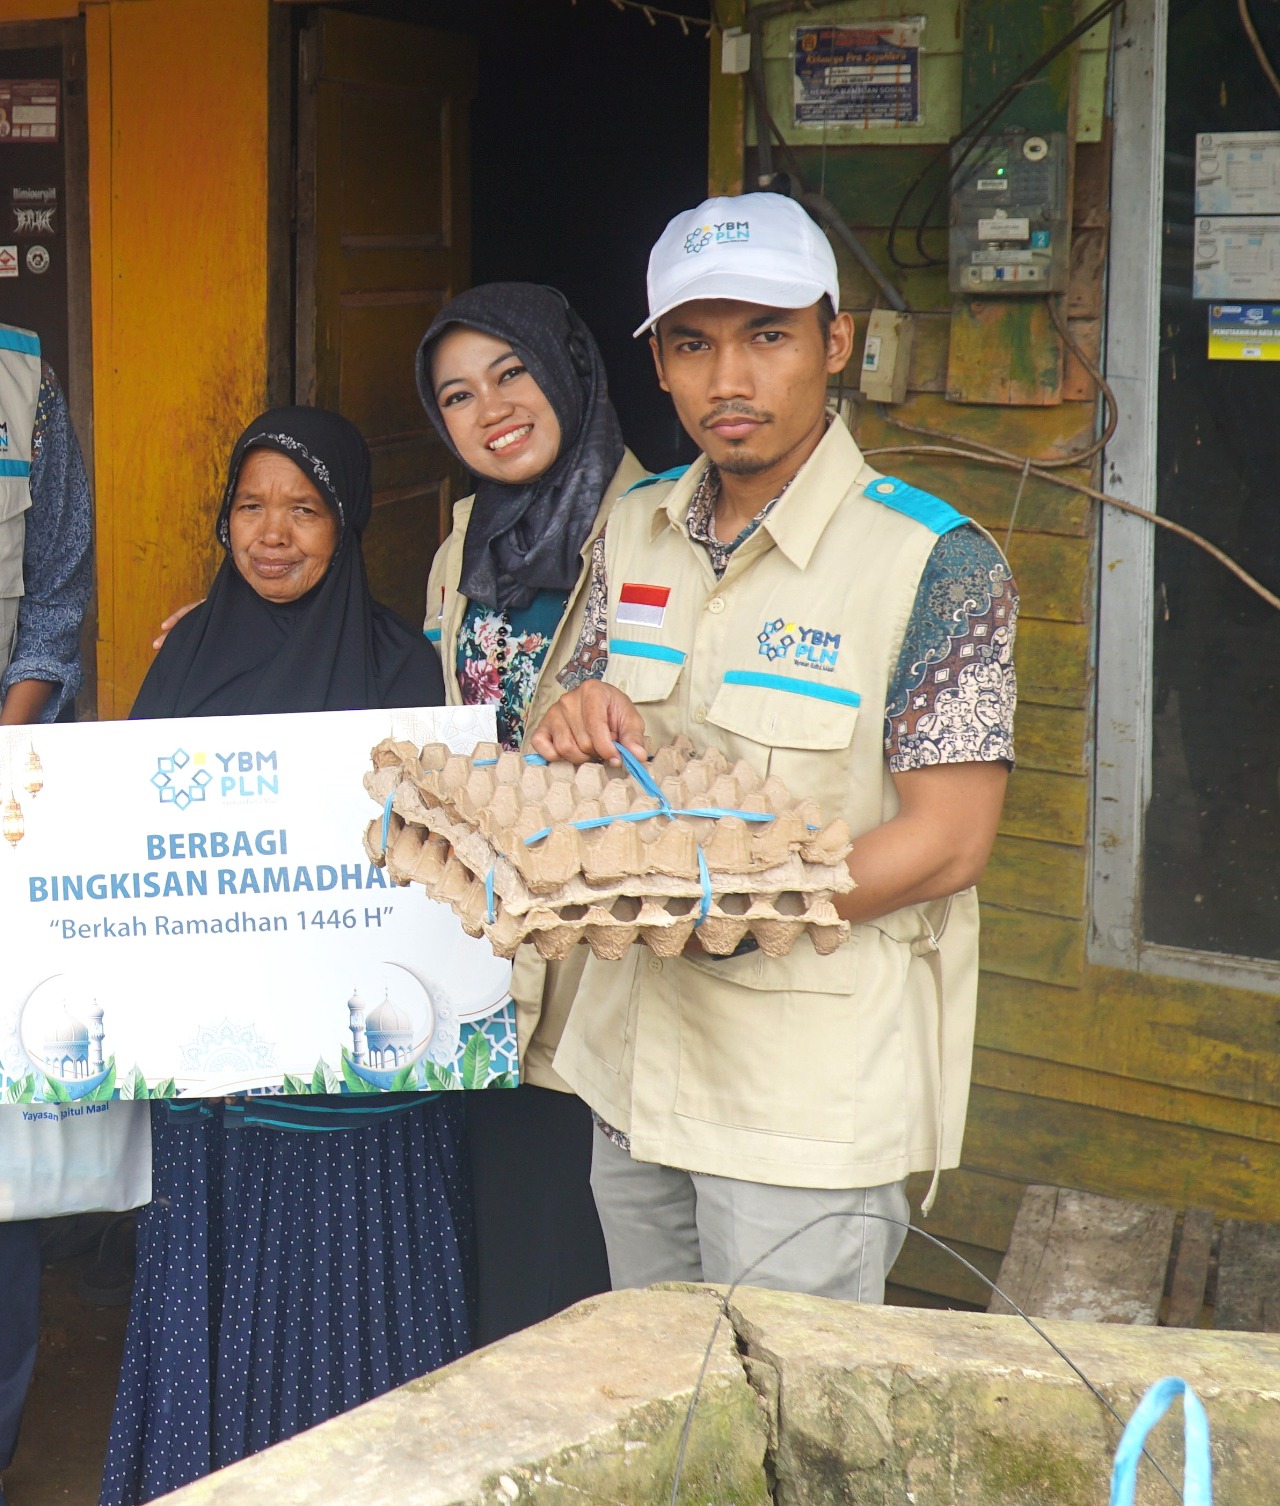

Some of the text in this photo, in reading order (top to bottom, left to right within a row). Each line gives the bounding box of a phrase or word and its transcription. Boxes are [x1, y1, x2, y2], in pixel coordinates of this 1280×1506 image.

[714, 221, 749, 231] YBM
[716, 230, 750, 240] PLN
[1037, 234, 1045, 244] 2
[798, 626, 841, 649] YBM
[795, 643, 838, 666] PLN
[215, 750, 278, 773] YBM
[221, 774, 279, 797] PLN
[146, 829, 288, 861] BERBAGI
[28, 863, 411, 902] BINGKISAN RAMADHA
[155, 912, 288, 936] Ramadhan
[297, 909, 357, 930] 1446
[22, 1111, 58, 1121] Yayasan
[86, 1101, 109, 1114] Maal
